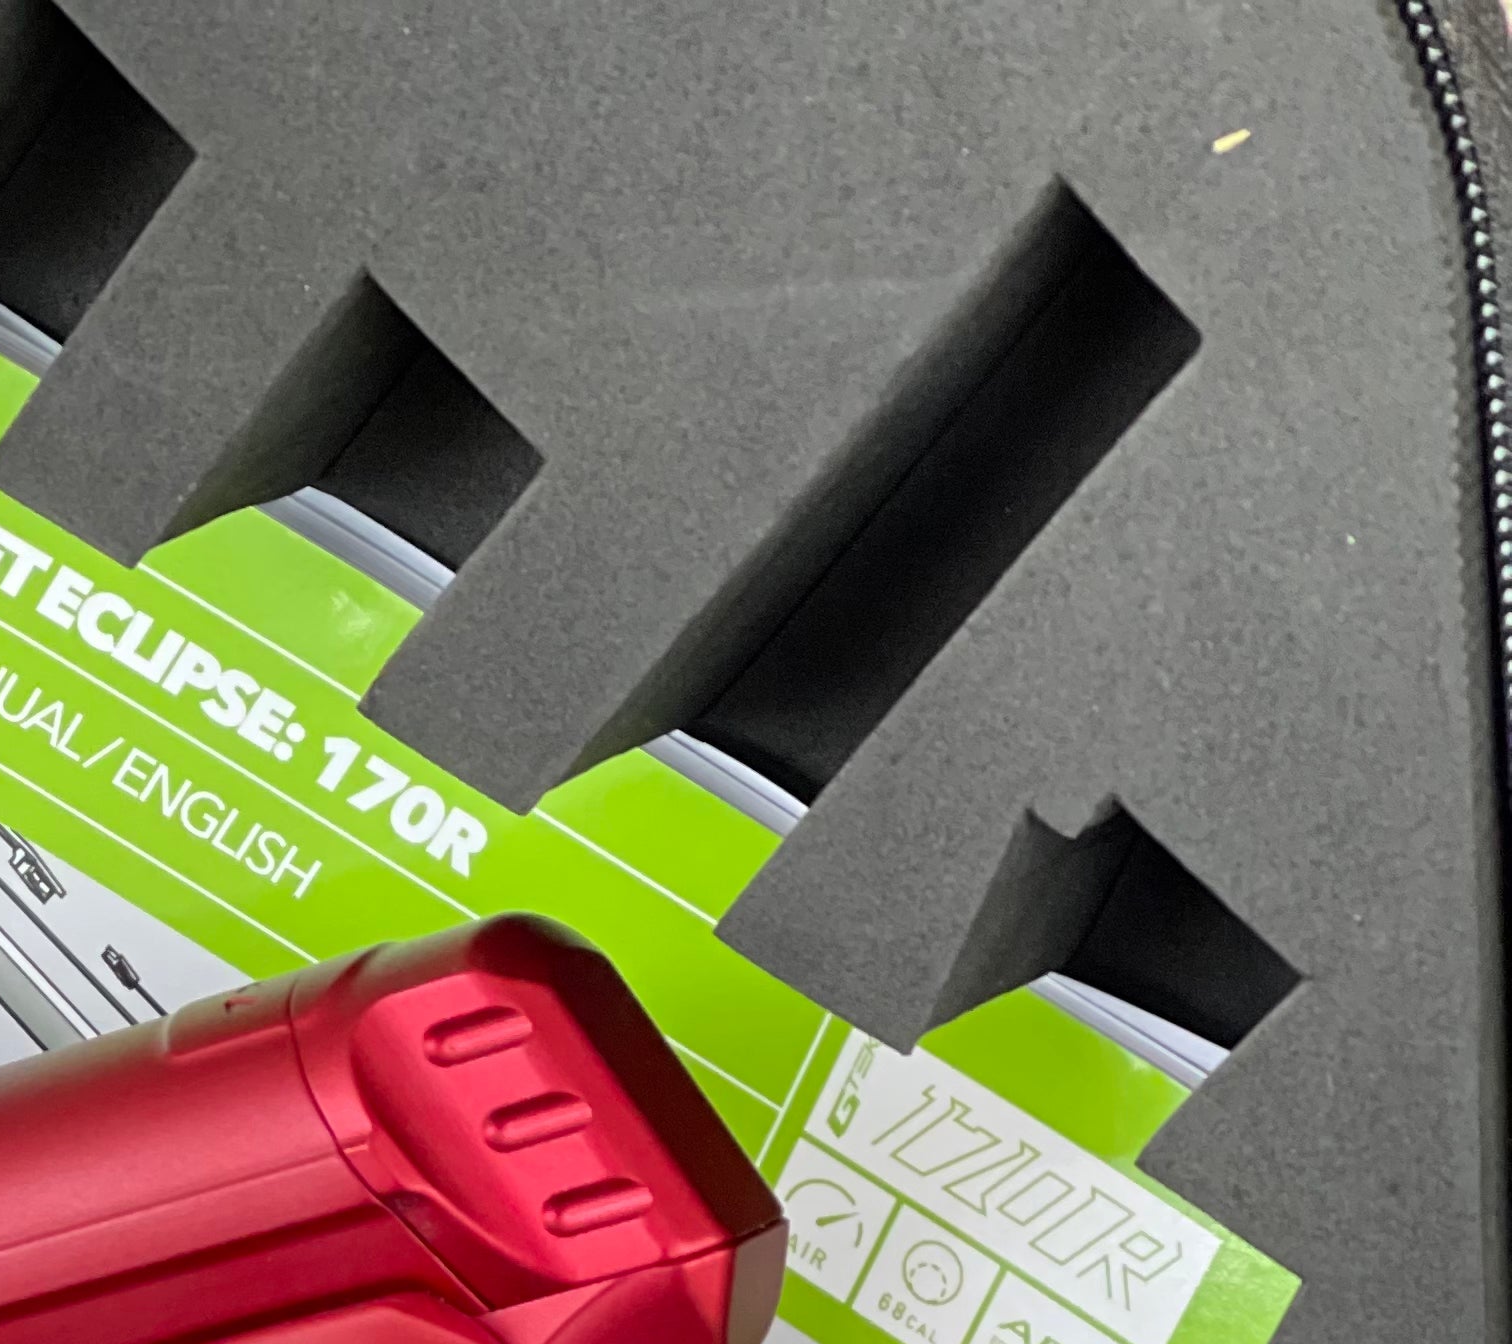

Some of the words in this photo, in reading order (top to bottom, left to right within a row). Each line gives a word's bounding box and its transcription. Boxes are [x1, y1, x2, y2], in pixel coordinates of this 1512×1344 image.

[37, 568, 307, 761] ECLIPSE:
[315, 735, 489, 879] 170R
[111, 751, 322, 900] ENGLISH
